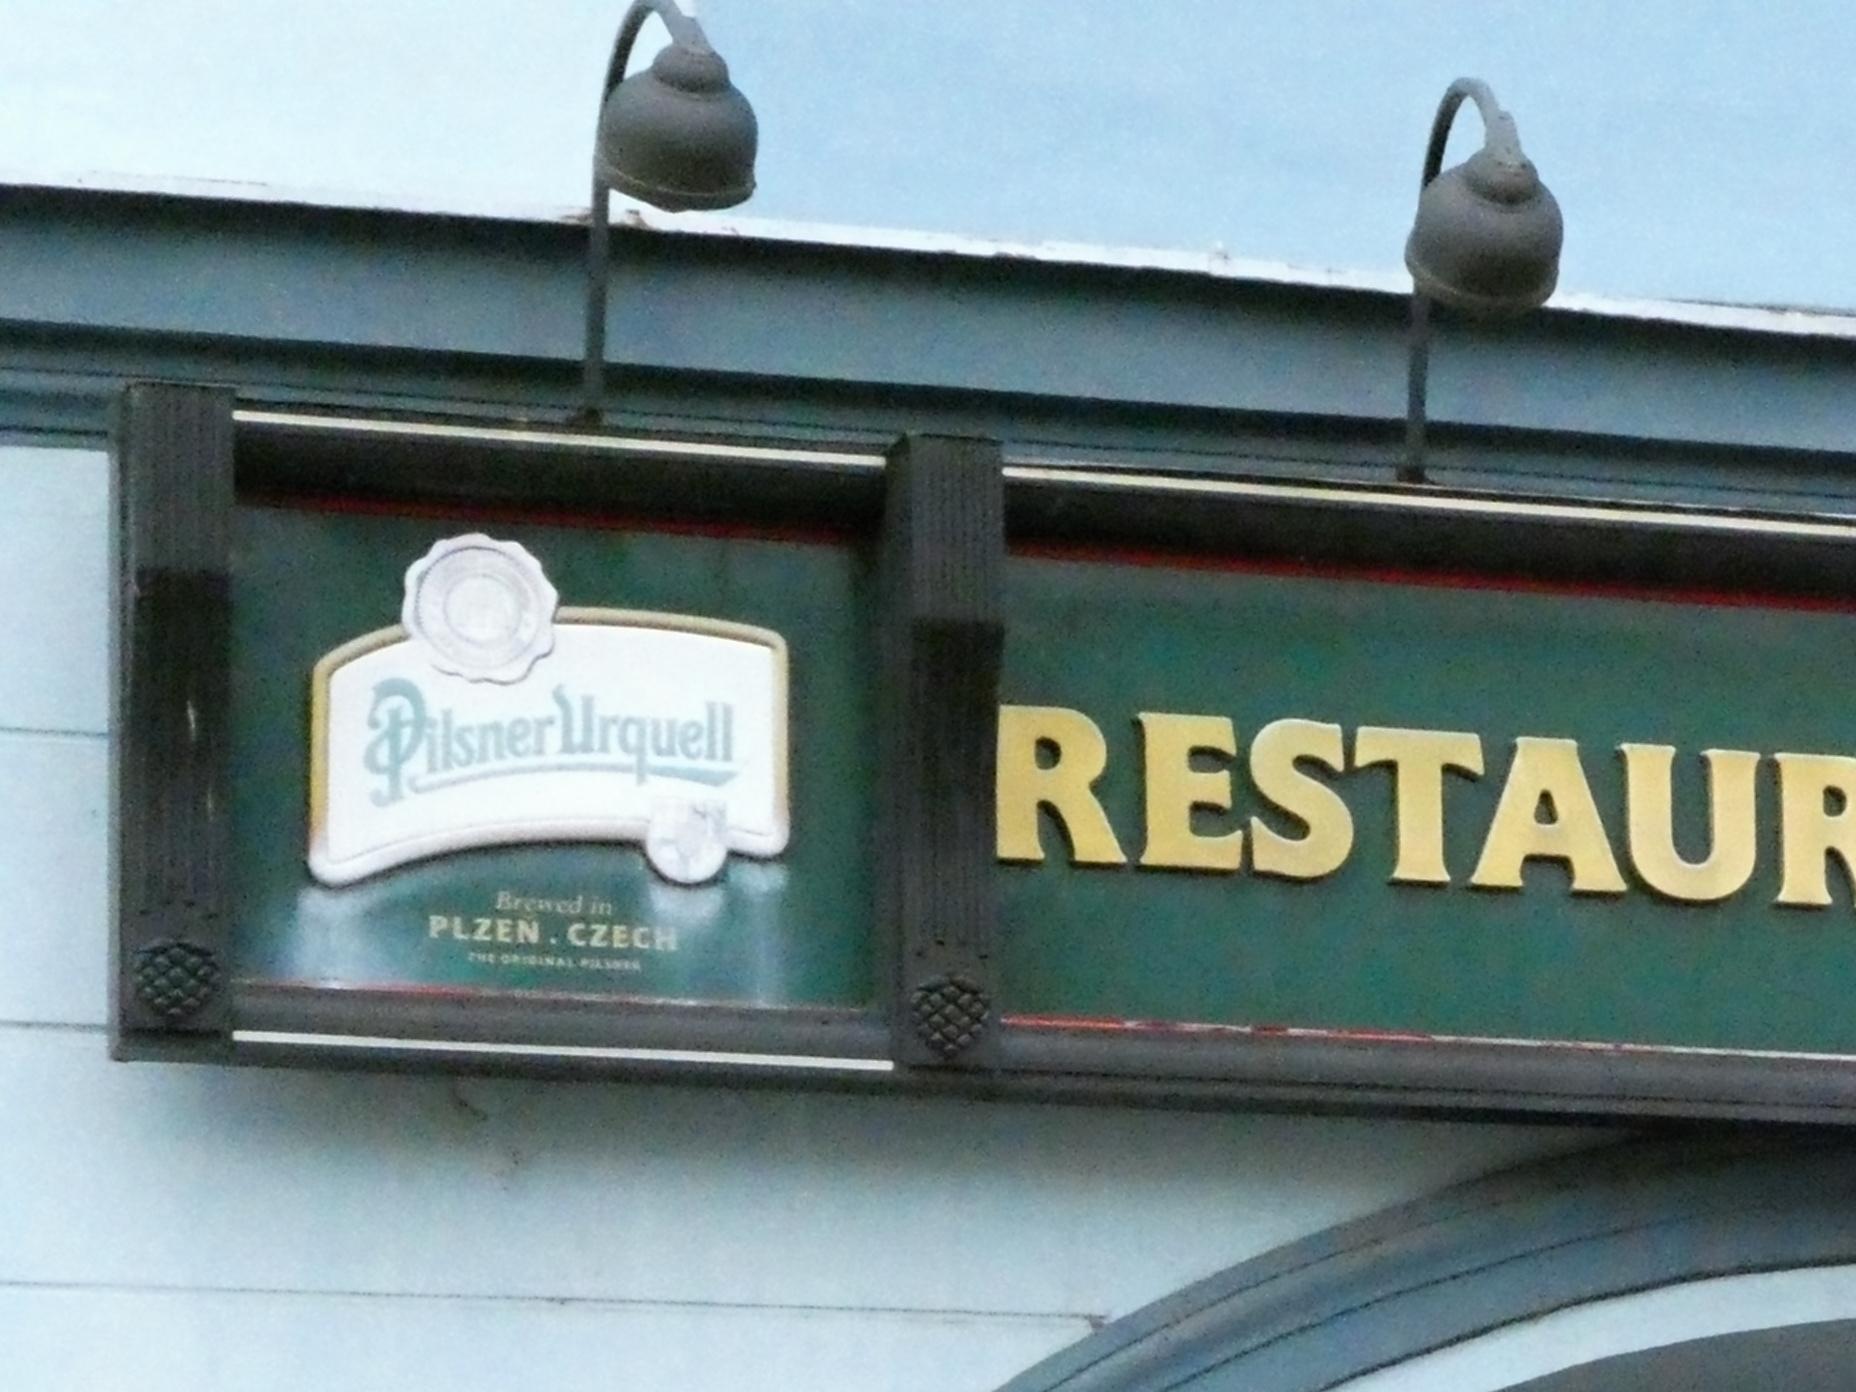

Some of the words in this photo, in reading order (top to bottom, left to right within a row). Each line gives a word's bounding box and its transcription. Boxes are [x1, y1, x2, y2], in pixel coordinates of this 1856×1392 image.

[363, 676, 555, 807] Pilsner
[551, 683, 734, 786] Urquell
[495, 890, 584, 916] Brewed
[591, 897, 613, 915] in
[566, 923, 676, 951] CZECH
